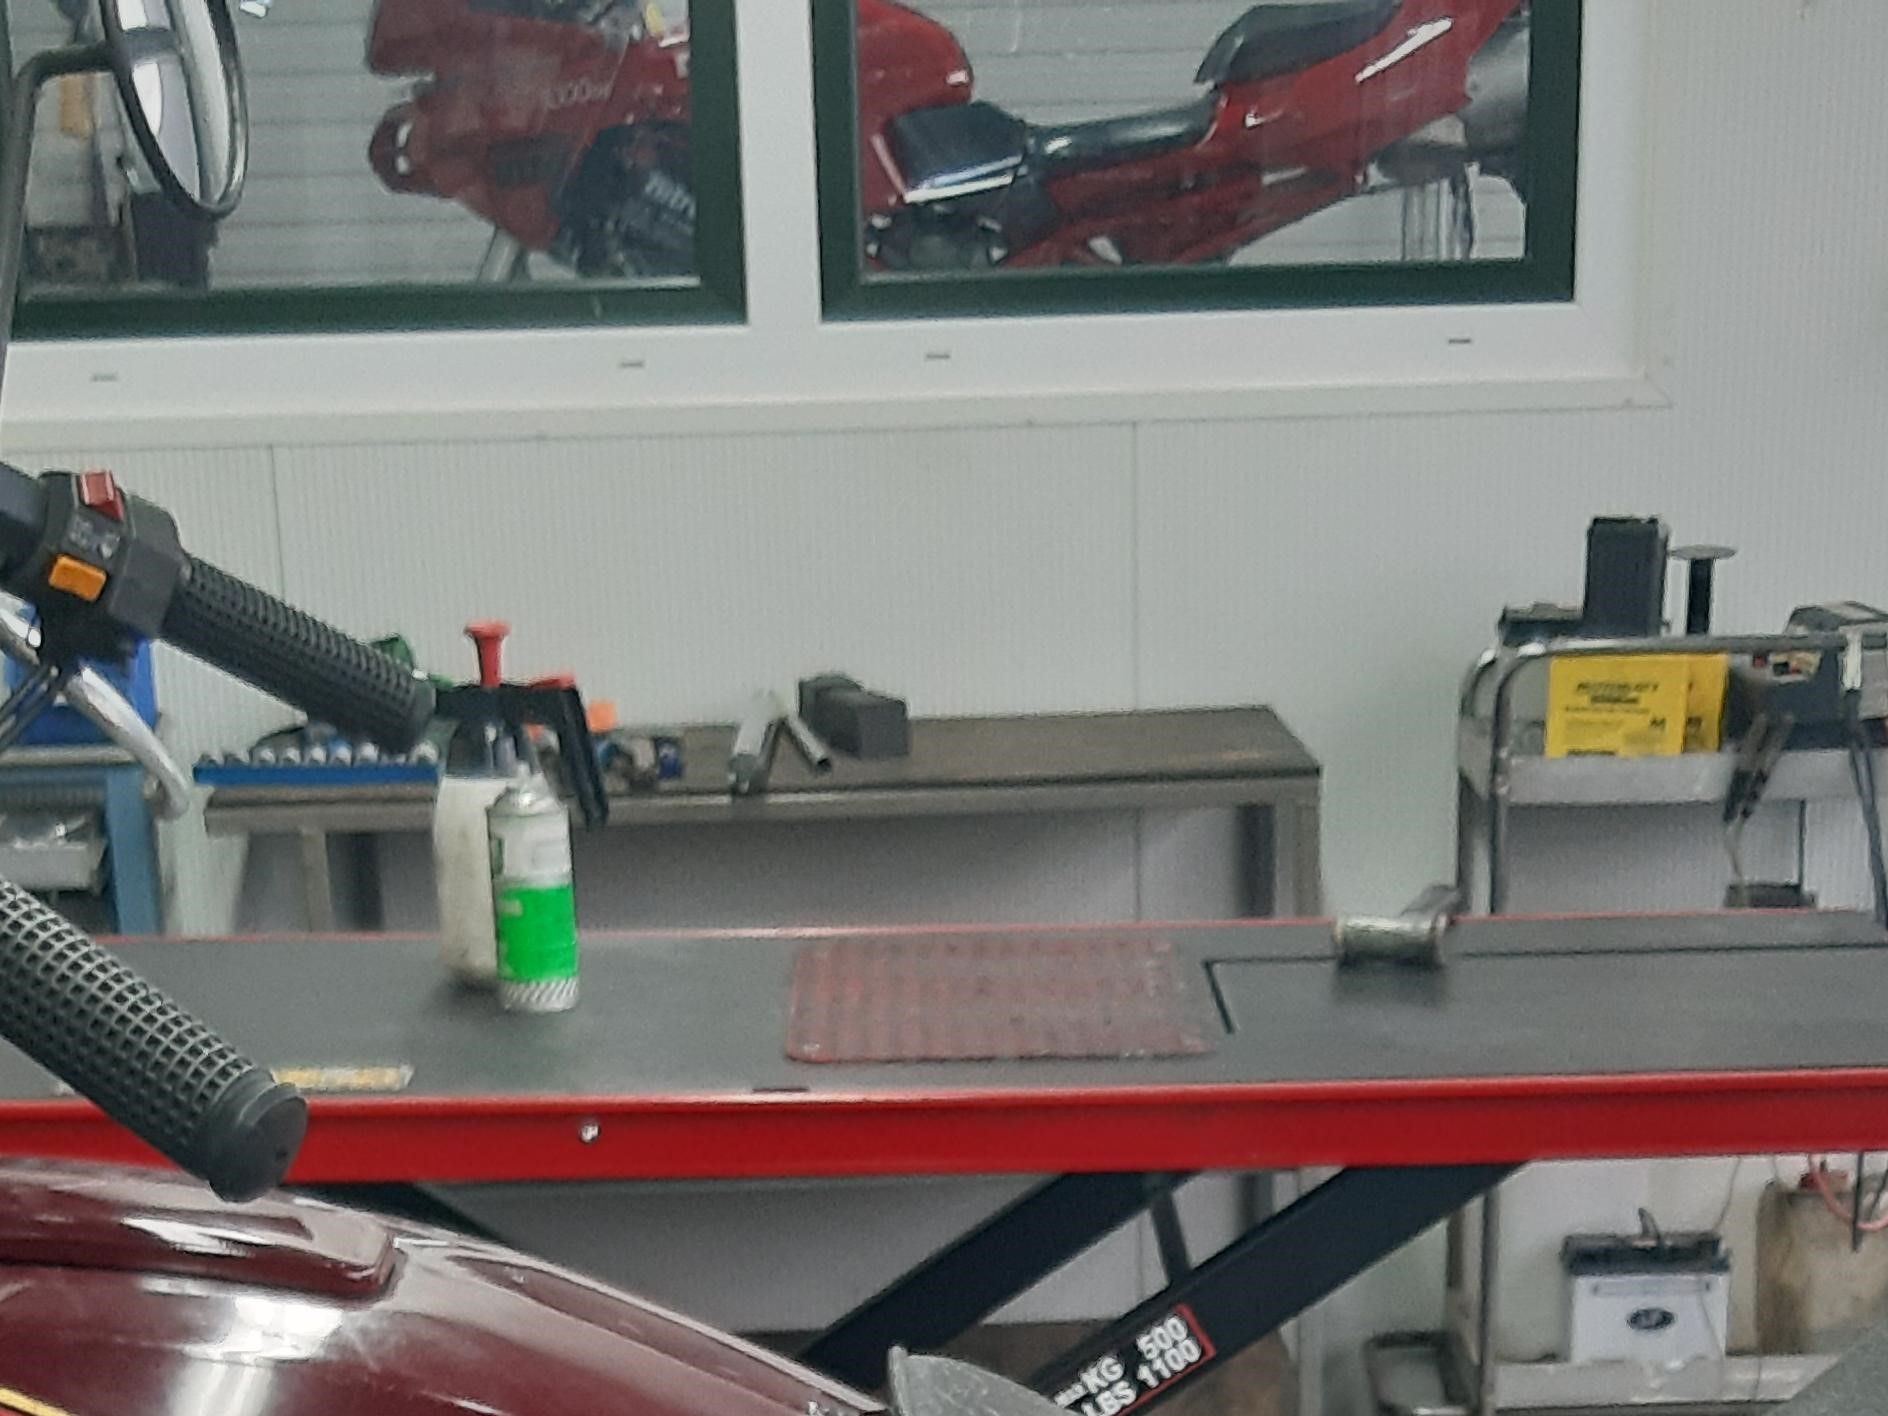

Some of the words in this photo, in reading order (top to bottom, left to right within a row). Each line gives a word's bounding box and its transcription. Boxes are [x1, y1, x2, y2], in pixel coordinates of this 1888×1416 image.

[1080, 1356, 1124, 1394] KG
[1136, 1314, 1188, 1360] 500
[1136, 1337, 1202, 1388] 1100
